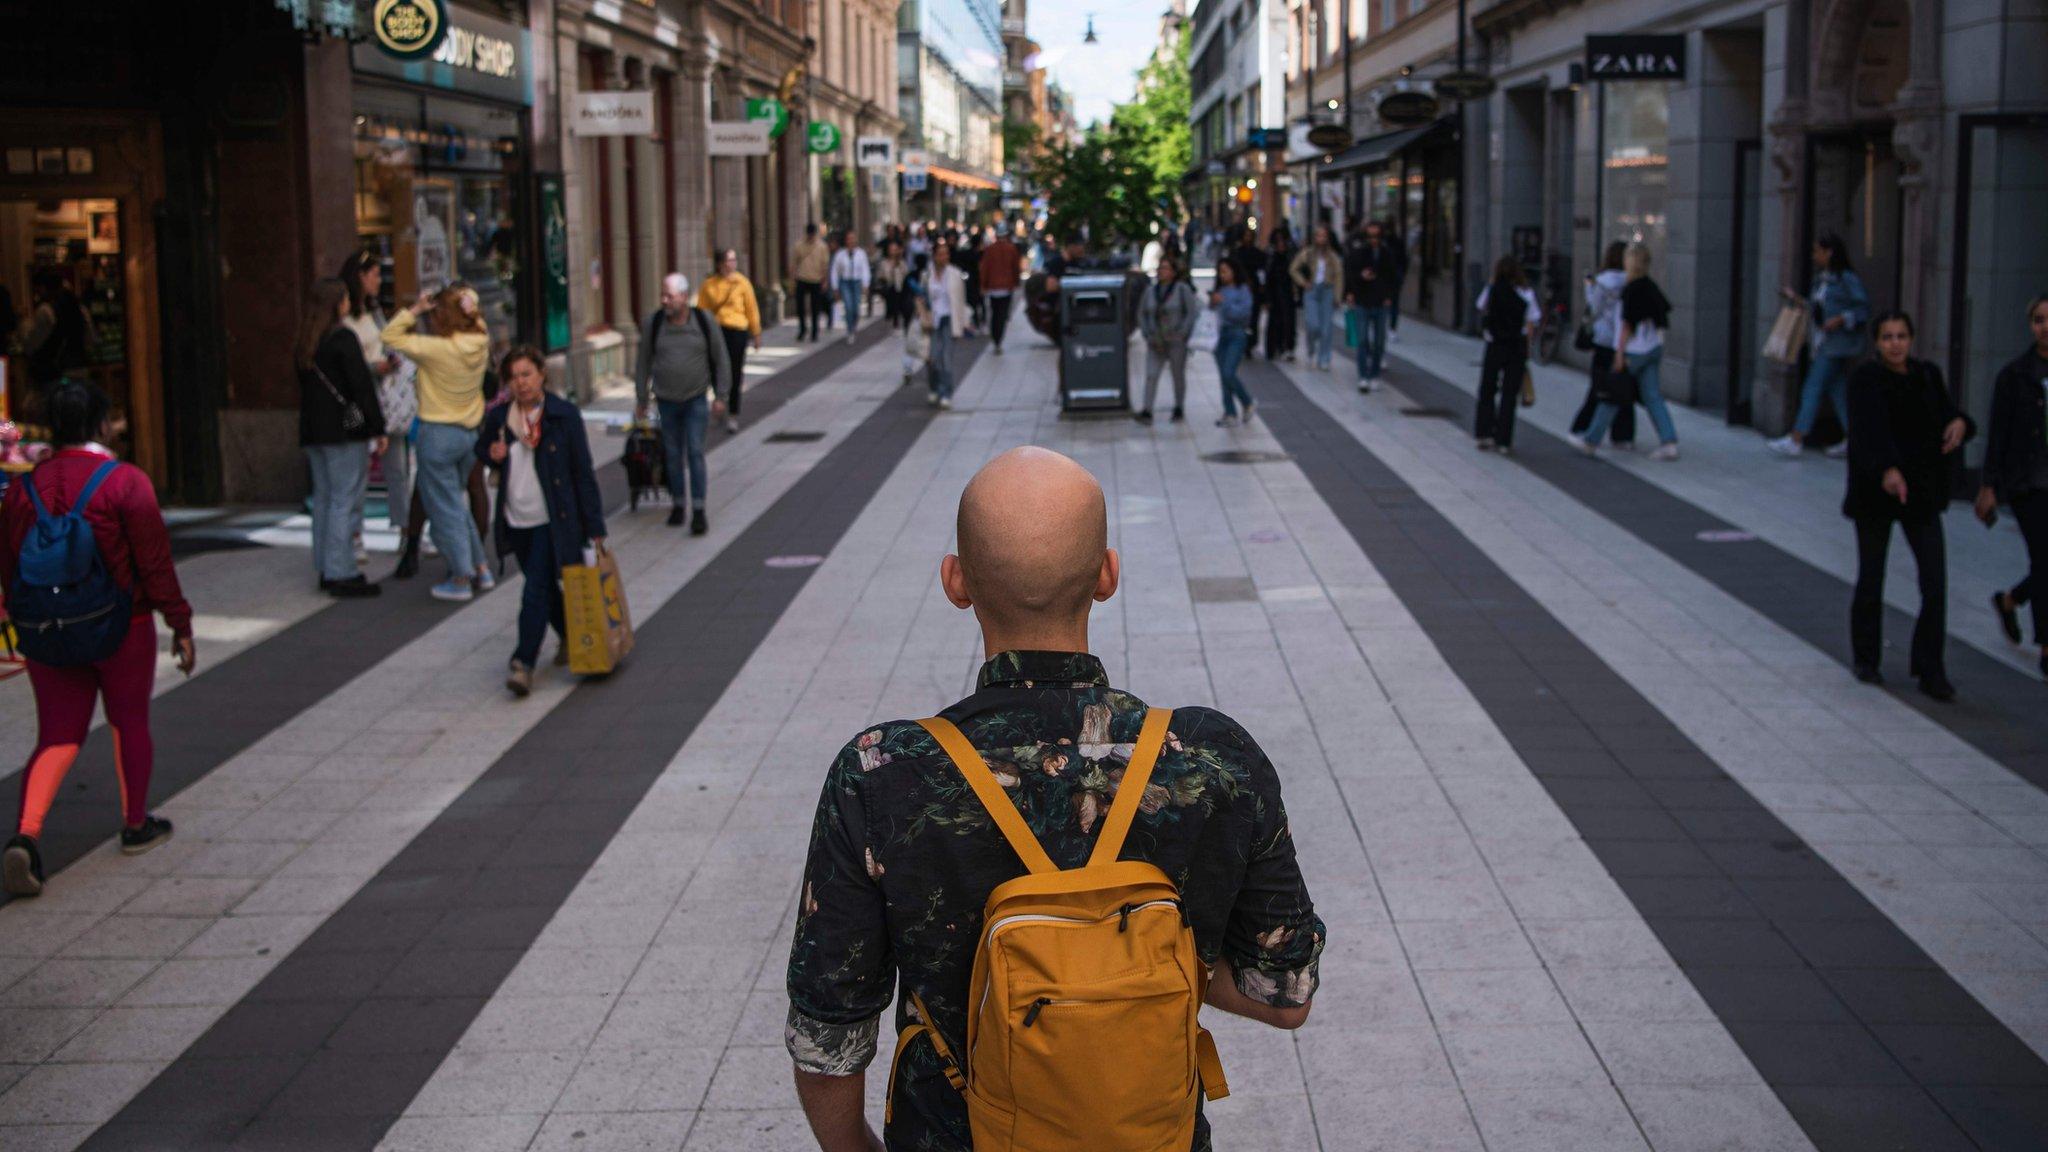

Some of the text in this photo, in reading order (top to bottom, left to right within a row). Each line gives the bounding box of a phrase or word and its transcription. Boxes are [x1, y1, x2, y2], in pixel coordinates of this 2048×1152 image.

[394, 5, 417, 16] THE
[386, 16, 427, 28] BODY
[388, 28, 425, 40] SHOP
[1593, 53, 1678, 73] ZARA
